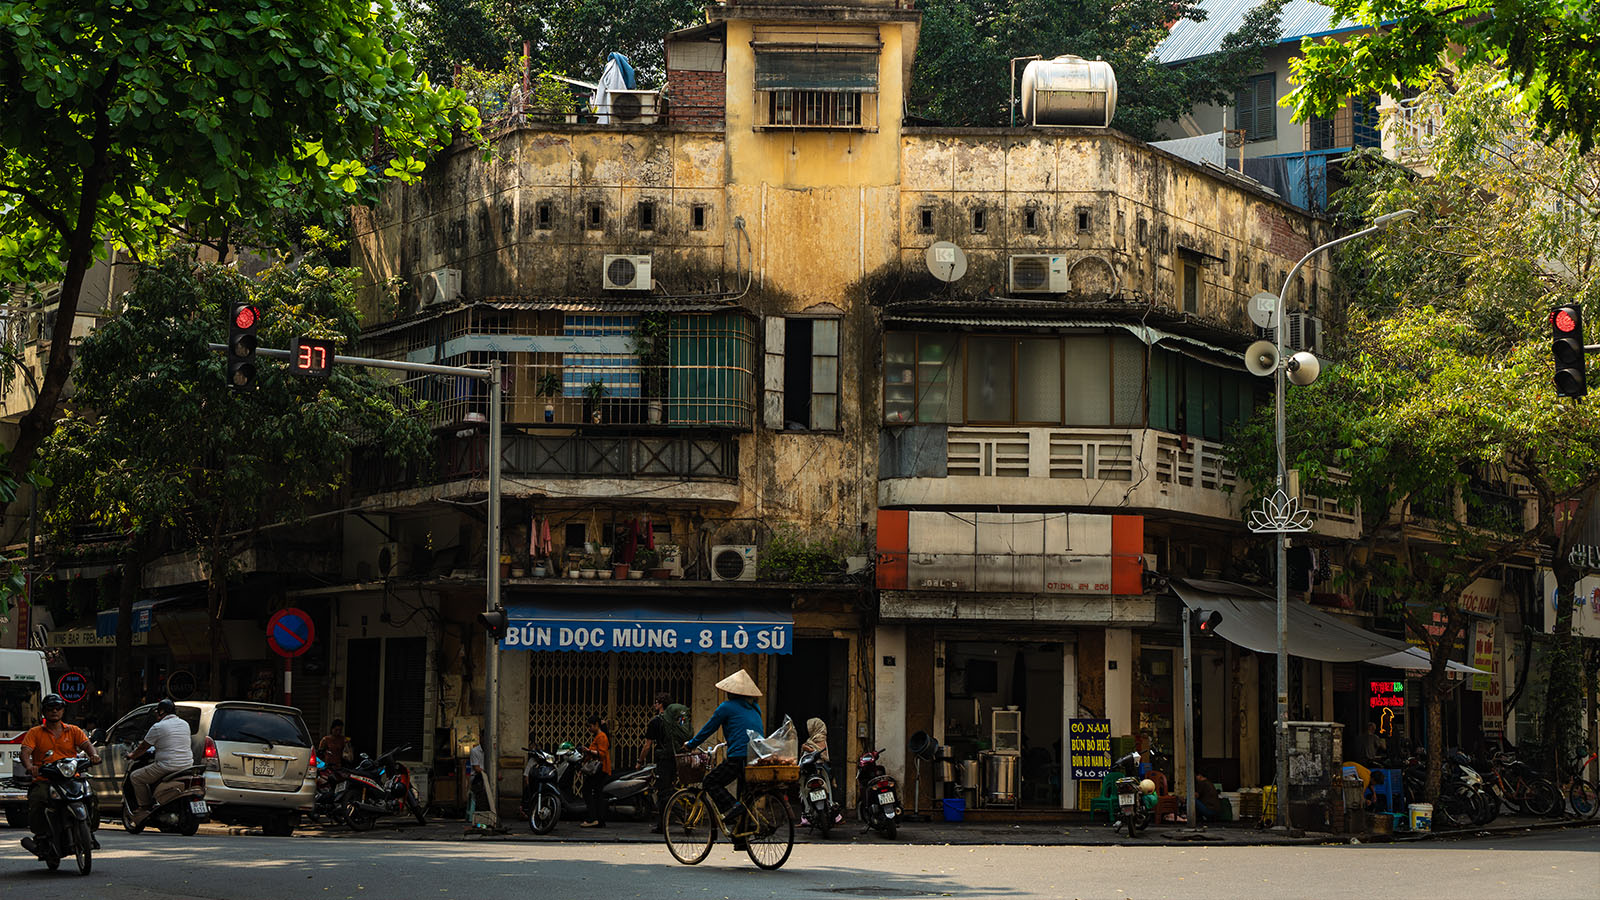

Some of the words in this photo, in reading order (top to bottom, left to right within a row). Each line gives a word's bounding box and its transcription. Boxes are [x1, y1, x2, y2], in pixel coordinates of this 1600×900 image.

[299, 345, 326, 369] 37
[505, 622, 551, 646] BÚN
[559, 627, 605, 650] DỌC
[612, 623, 677, 648] MÙNG
[698, 629, 713, 648] 8
[720, 625, 749, 648] LÒ
[756, 626, 785, 650] SŨ
[1071, 722, 1084, 733] CÔ
[1086, 723, 1109, 733] NAM
[1071, 736, 1085, 751] BÚN
[1086, 736, 1095, 751] BÒ
[1096, 734, 1110, 751] HUẾ
[1072, 753, 1083, 767] BÚN
[1091, 755, 1103, 767] NAM
[1075, 769, 1083, 778] 8
